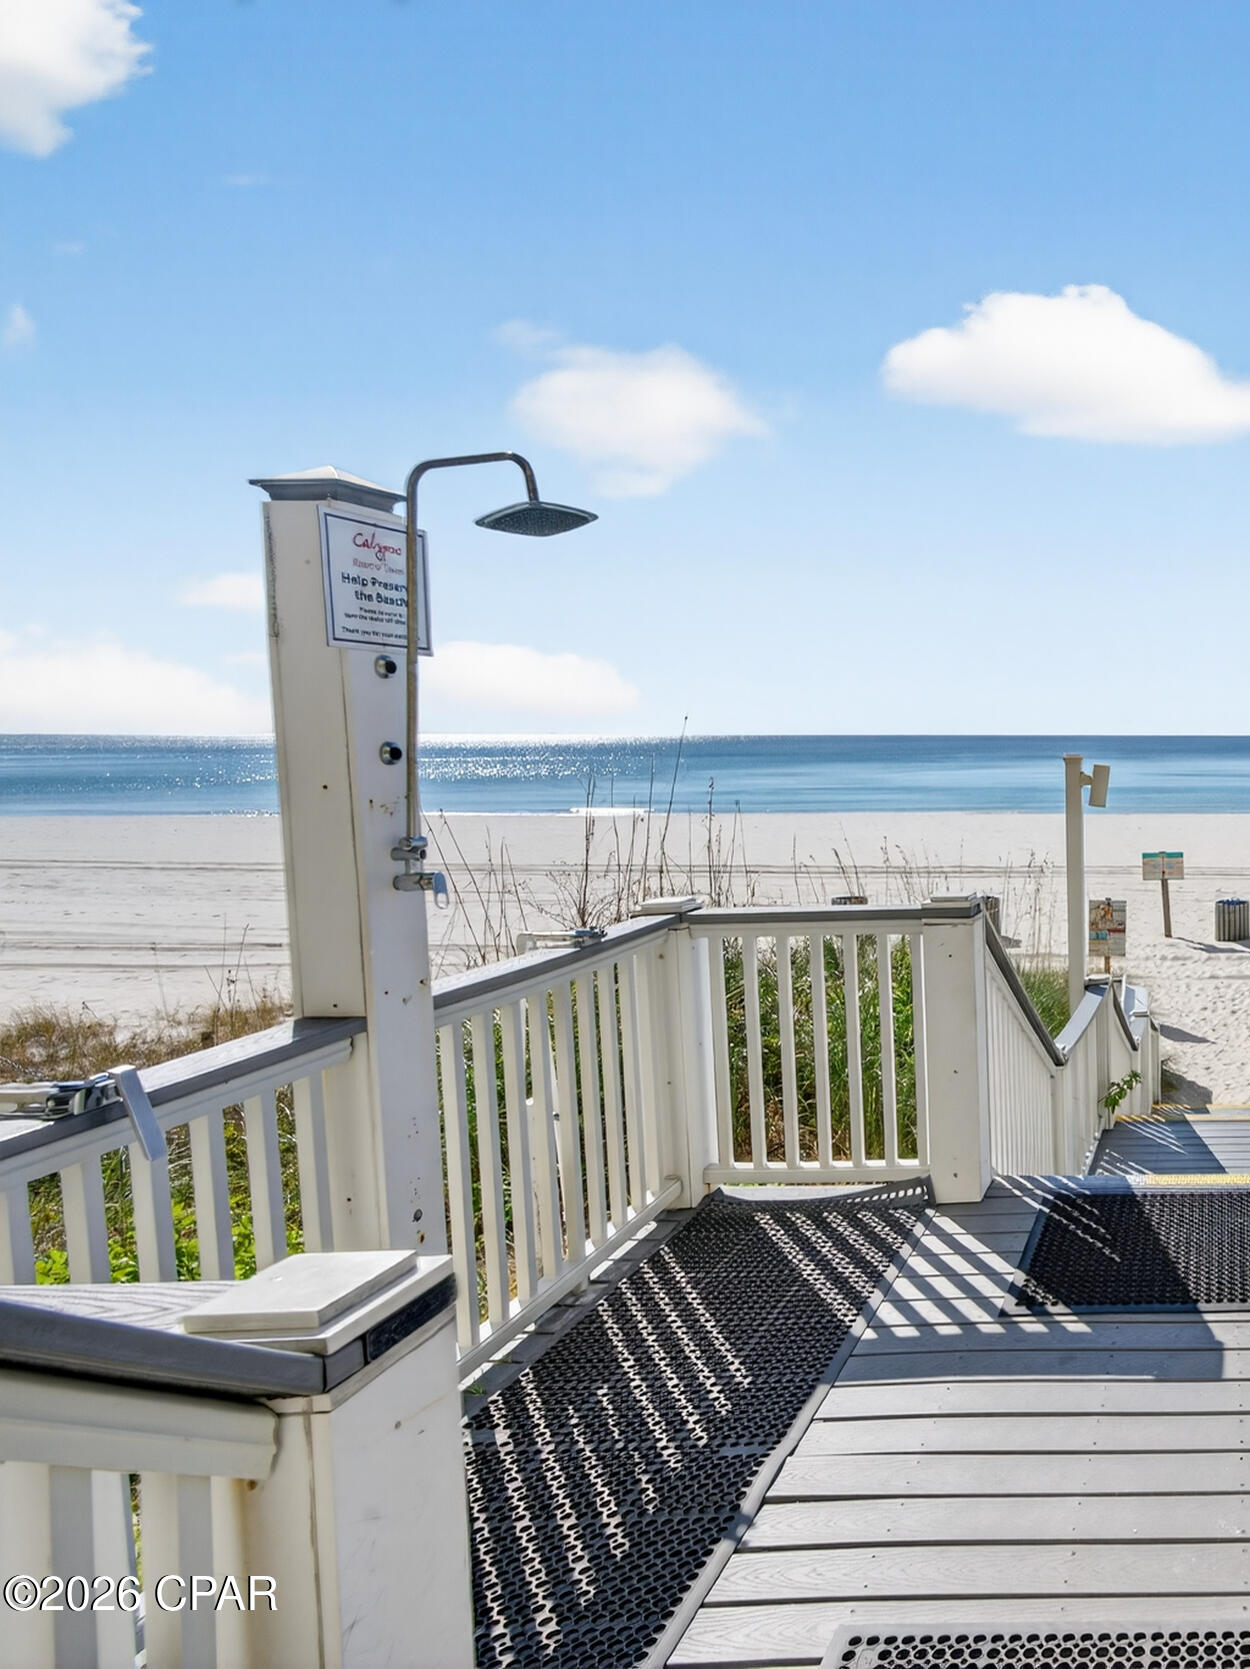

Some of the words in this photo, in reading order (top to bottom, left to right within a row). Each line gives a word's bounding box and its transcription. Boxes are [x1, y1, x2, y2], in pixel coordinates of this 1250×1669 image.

[352, 532, 402, 562] Calypso
[341, 572, 368, 587] Help
[354, 590, 374, 603] the
[376, 592, 408, 608] Beach
